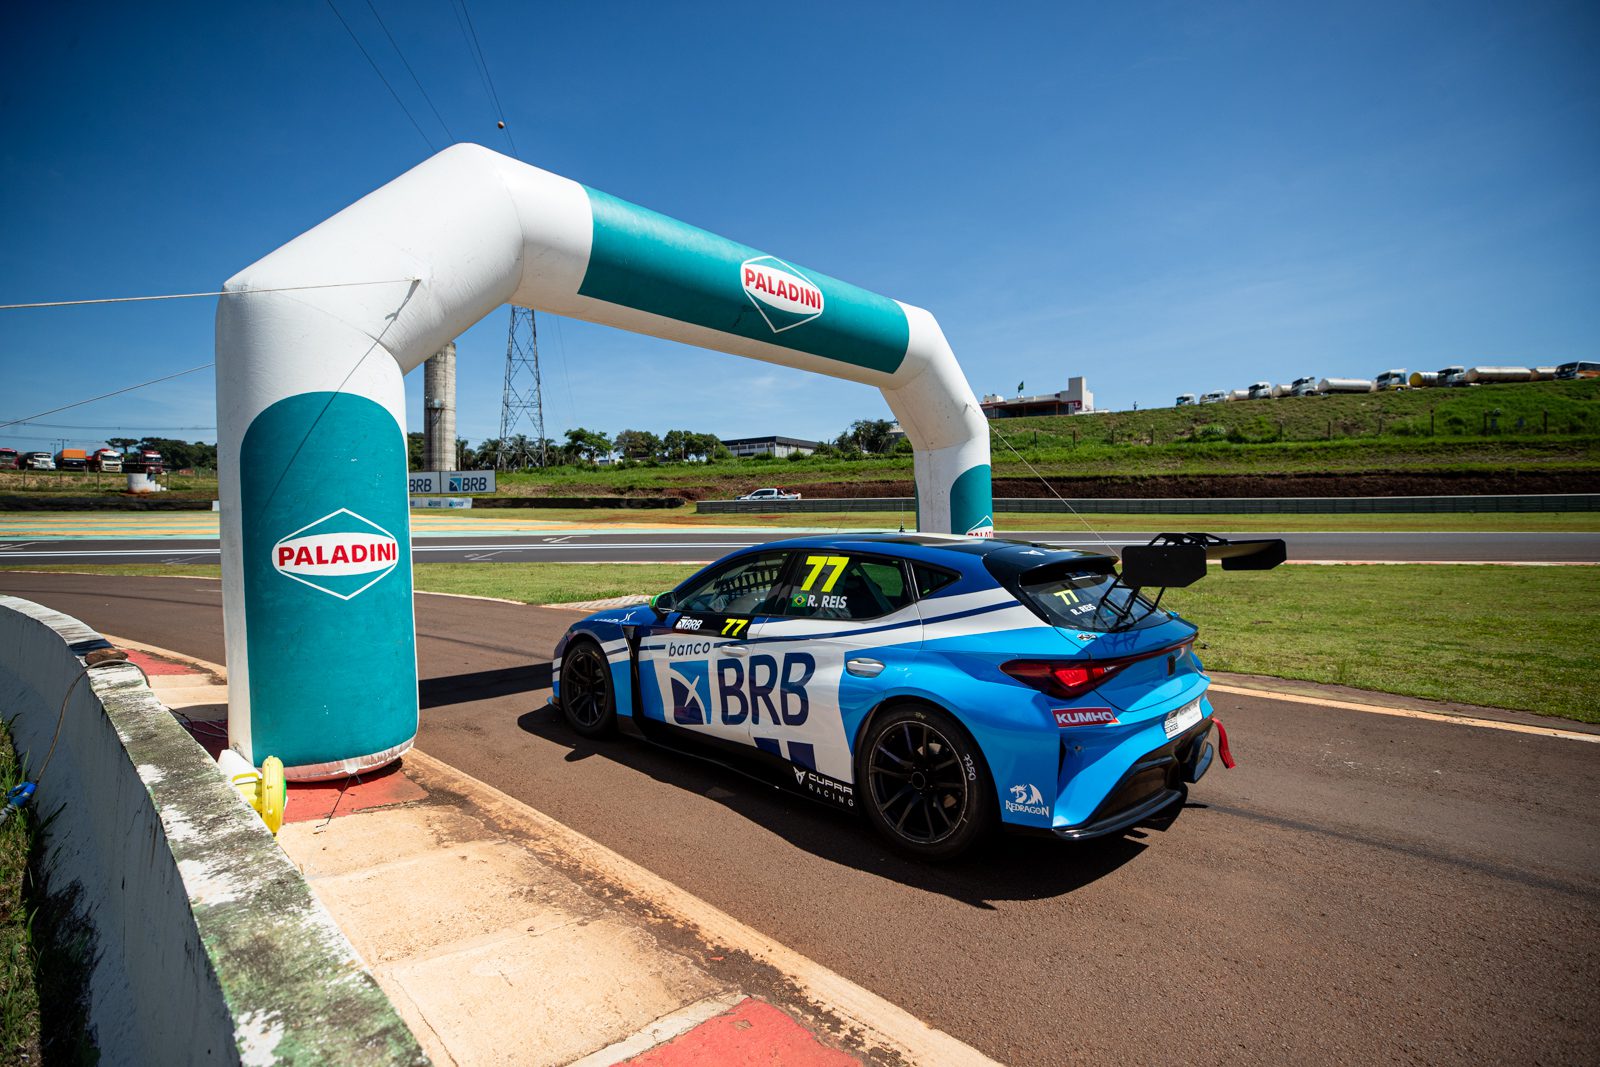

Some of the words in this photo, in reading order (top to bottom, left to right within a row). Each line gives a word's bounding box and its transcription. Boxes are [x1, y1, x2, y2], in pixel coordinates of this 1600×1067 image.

[744, 268, 821, 309] PALADINI
[462, 477, 487, 491] BRB
[278, 543, 396, 567] PALADINI
[800, 555, 850, 593] 77
[807, 595, 819, 608] R.
[821, 595, 847, 609] REIS
[1053, 589, 1080, 606] 77
[1080, 603, 1097, 614] REIS
[683, 619, 703, 631] BRB
[720, 618, 749, 637] 77
[668, 642, 711, 657] banco
[717, 652, 816, 726] BRB
[1055, 711, 1114, 724] KUMHO
[808, 772, 853, 796] CUPRA
[808, 783, 854, 807] RACING
[1005, 799, 1050, 818] REDRAGON
